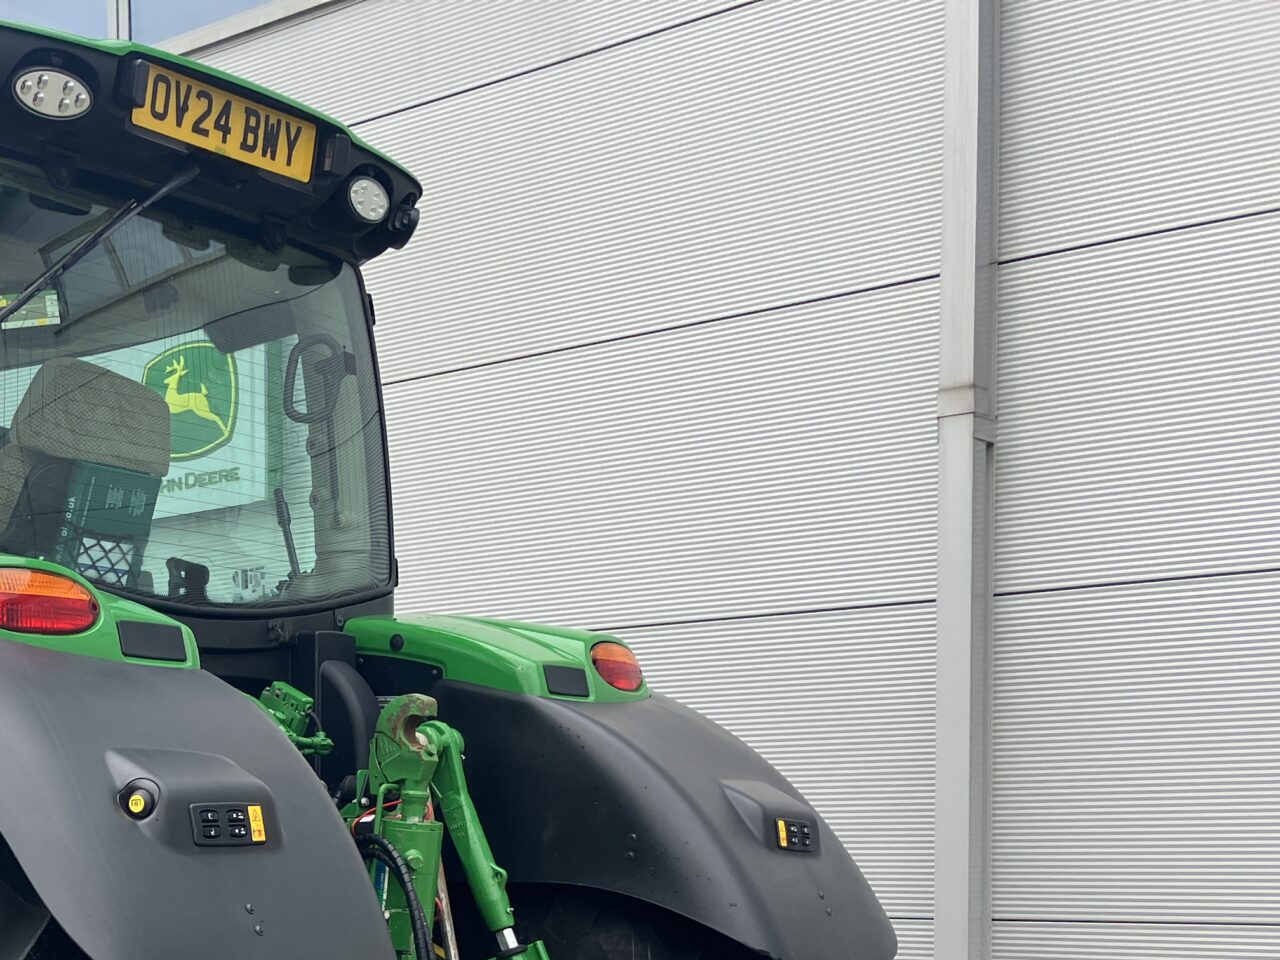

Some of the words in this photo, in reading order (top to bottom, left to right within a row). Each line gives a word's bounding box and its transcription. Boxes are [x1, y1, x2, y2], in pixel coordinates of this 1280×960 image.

[151, 73, 233, 145] OV24
[239, 106, 303, 167] BWY
[184, 466, 240, 490] DEERE
